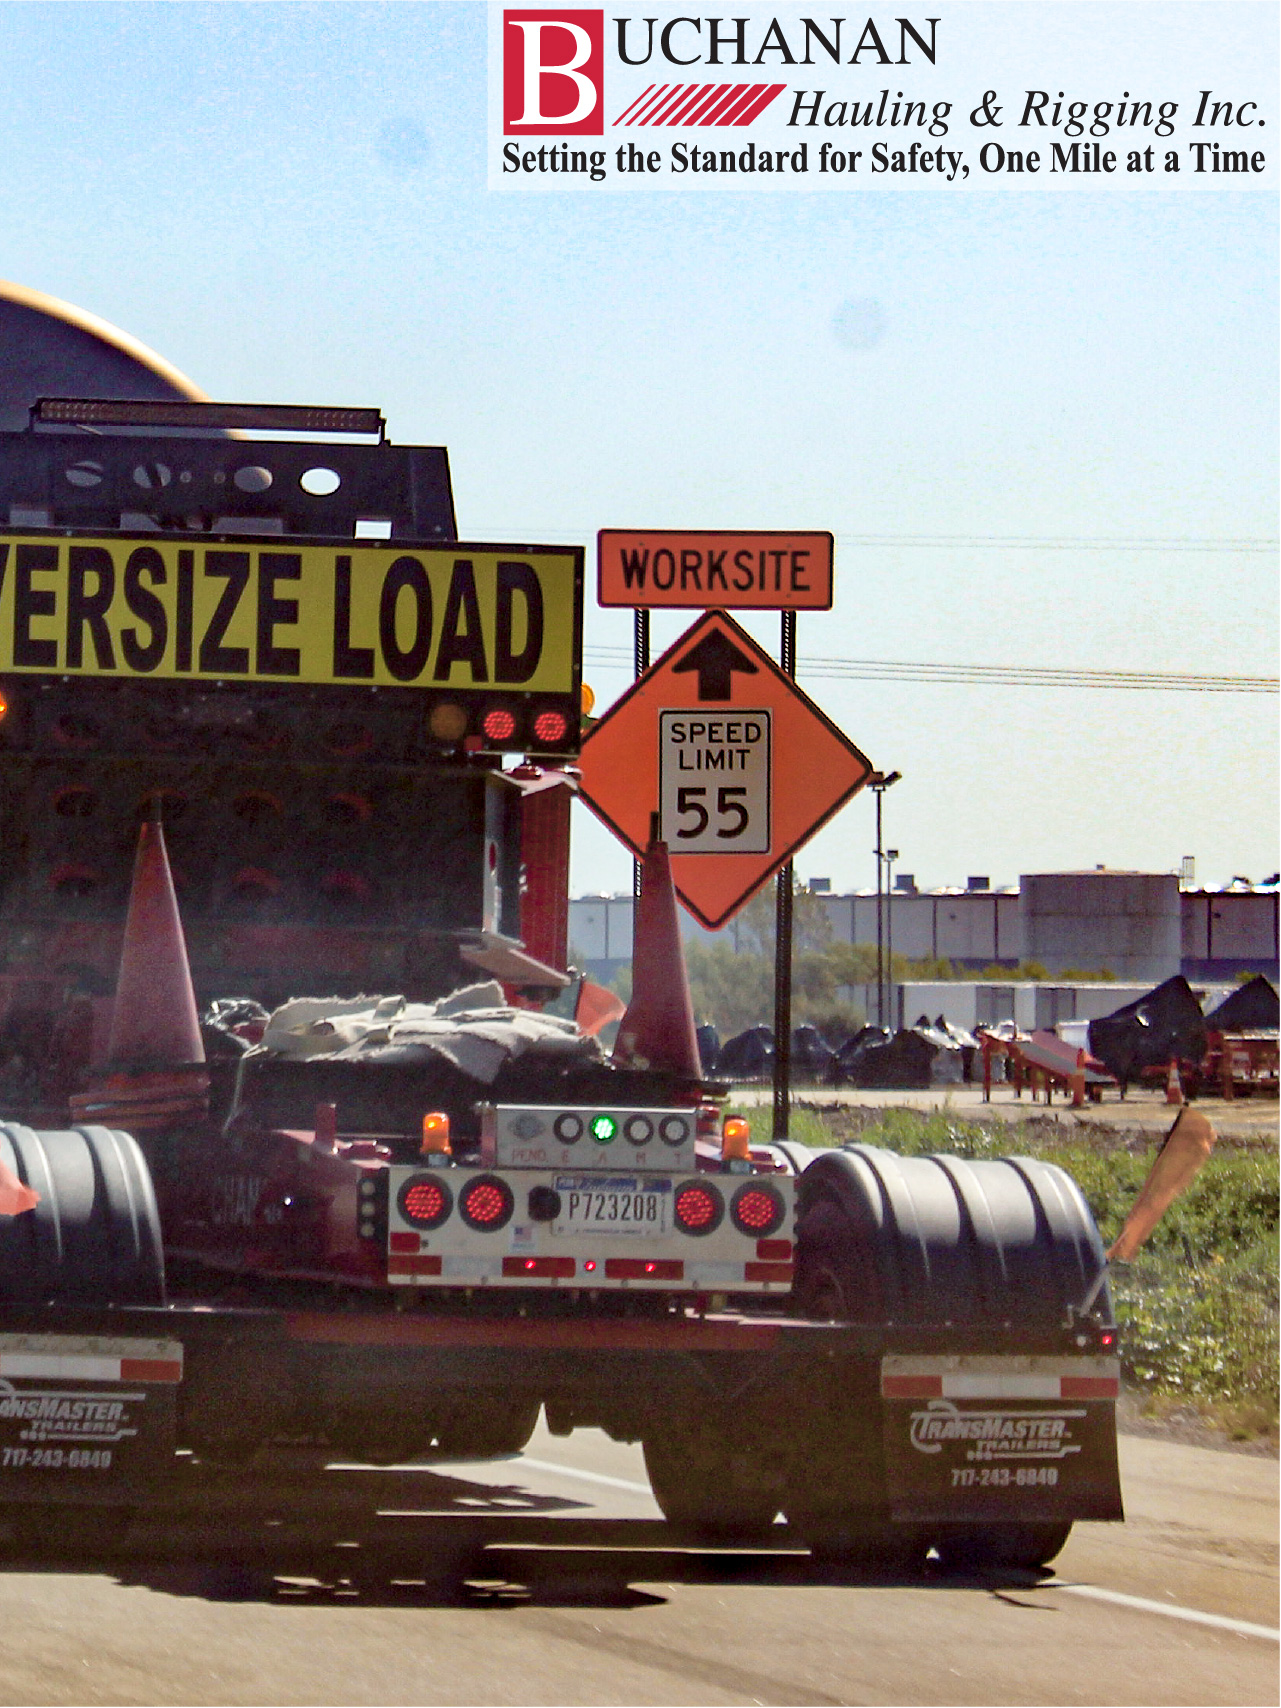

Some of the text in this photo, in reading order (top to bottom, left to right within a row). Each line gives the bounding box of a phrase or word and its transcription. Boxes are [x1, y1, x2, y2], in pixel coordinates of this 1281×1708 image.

[620, 548, 811, 592] WORKSITE
[332, 554, 544, 684] LOAD
[670, 721, 762, 745] SPEED
[678, 748, 751, 771] LIMIT
[676, 786, 750, 840] 55
[569, 1193, 657, 1222] P723208
